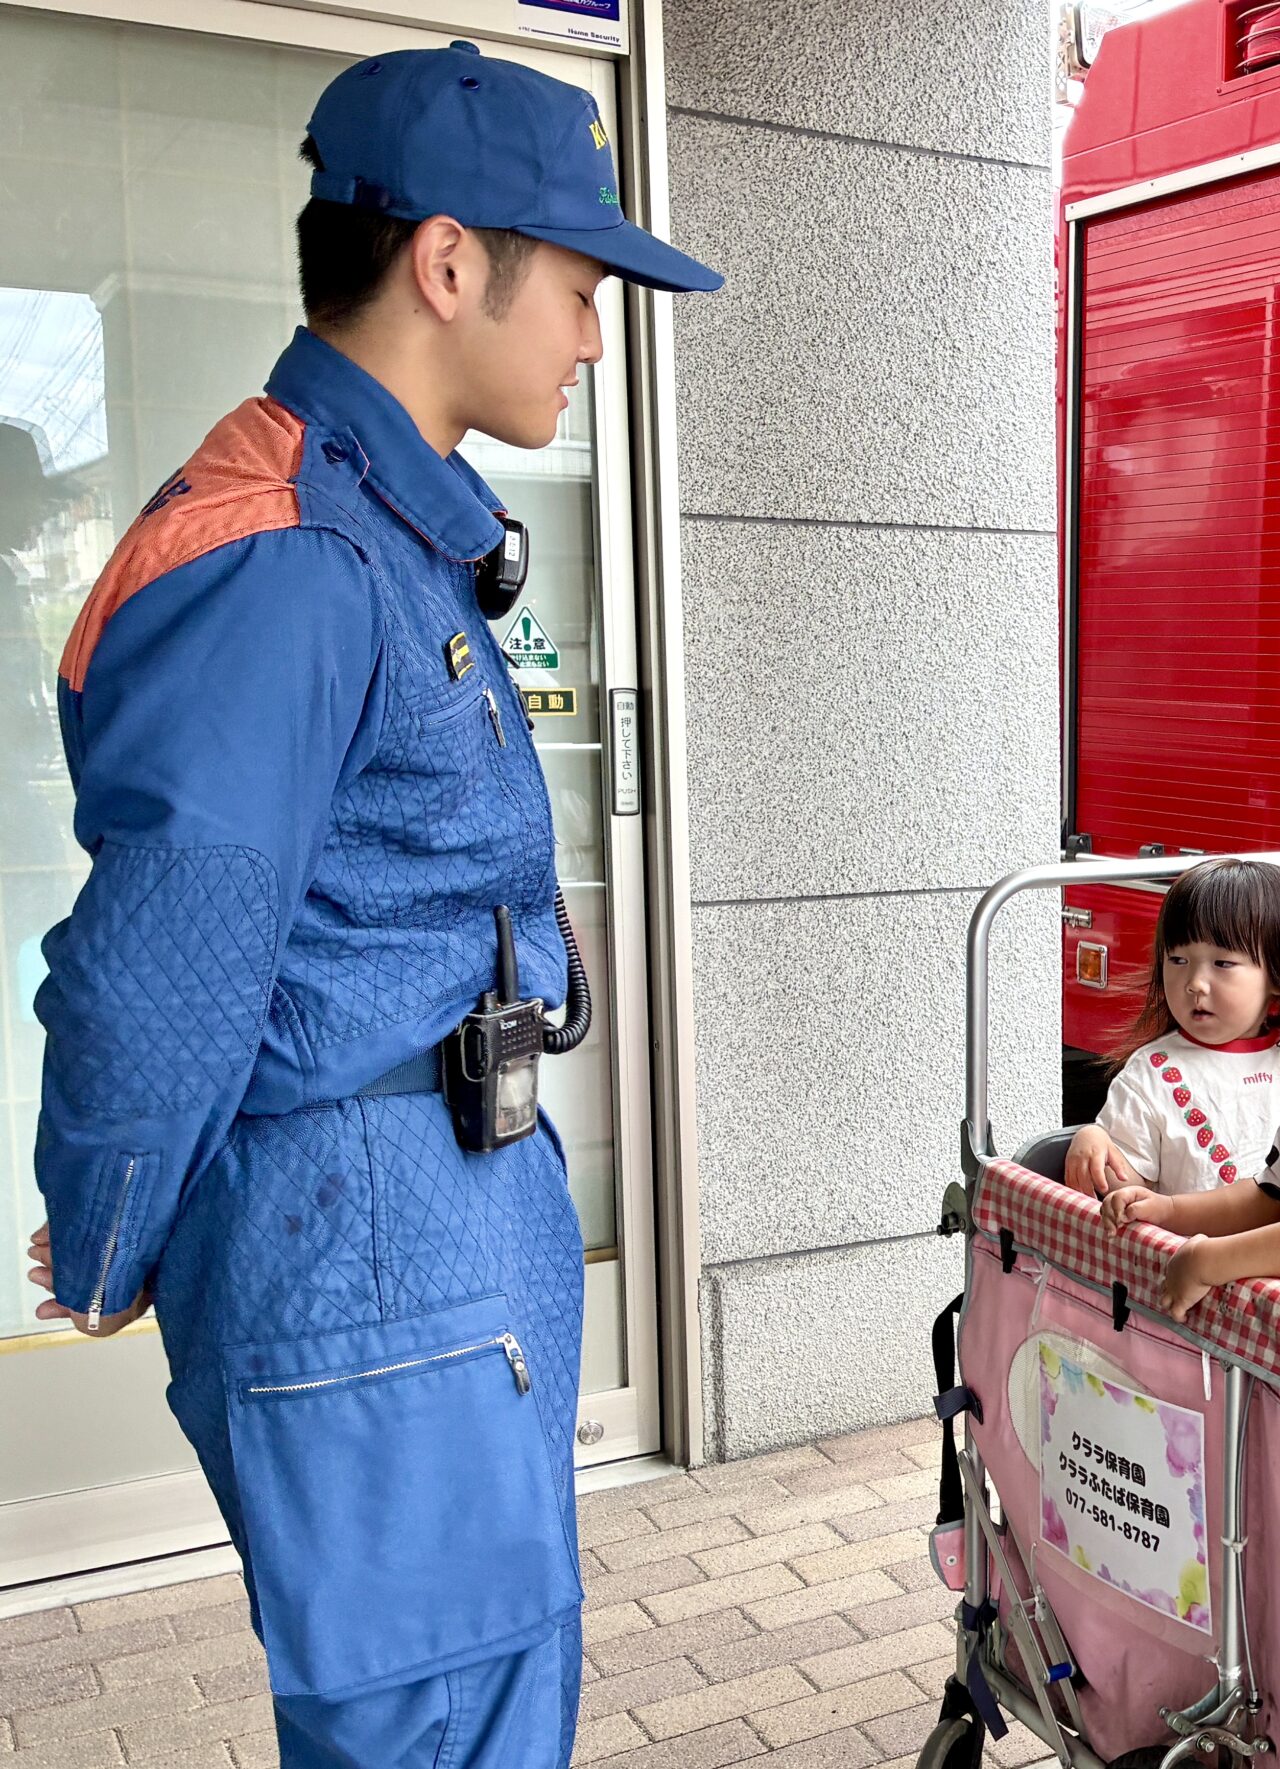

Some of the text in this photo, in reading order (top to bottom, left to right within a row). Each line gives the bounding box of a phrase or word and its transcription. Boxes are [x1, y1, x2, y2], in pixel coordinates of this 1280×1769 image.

[567, 28, 620, 43] Home Security
[588, 119, 609, 150] K
[528, 694, 564, 710] 自動
[620, 716, 633, 781] 押して下さい
[1242, 1071, 1273, 1085] miffy
[1072, 1431, 1146, 1487] クララ保育園
[1059, 1451, 1170, 1529] クララふたば保育園
[1065, 1487, 1161, 1553] 077-581-8787
